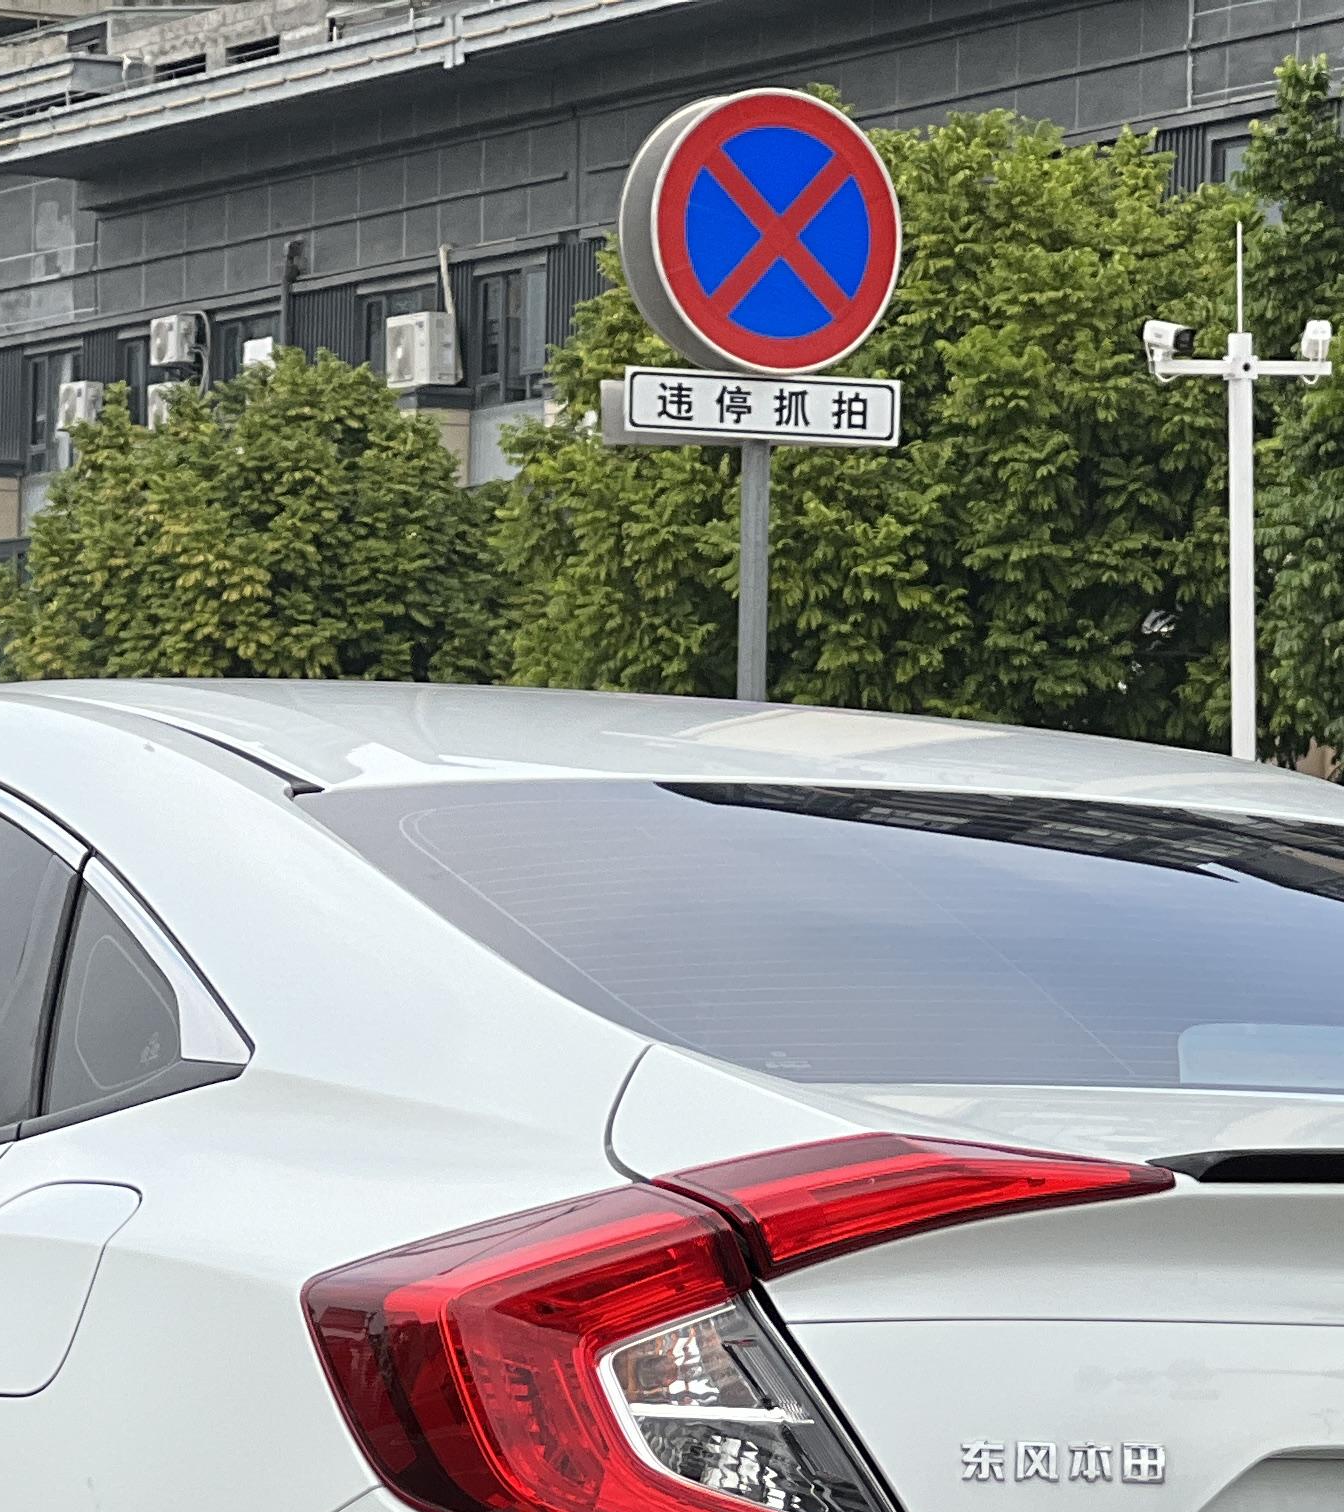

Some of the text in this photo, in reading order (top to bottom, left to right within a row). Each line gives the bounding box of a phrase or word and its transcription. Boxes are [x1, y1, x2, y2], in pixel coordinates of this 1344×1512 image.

[657, 382, 868, 430] 违停抓拍
[960, 1440, 1166, 1484] 东风本田
